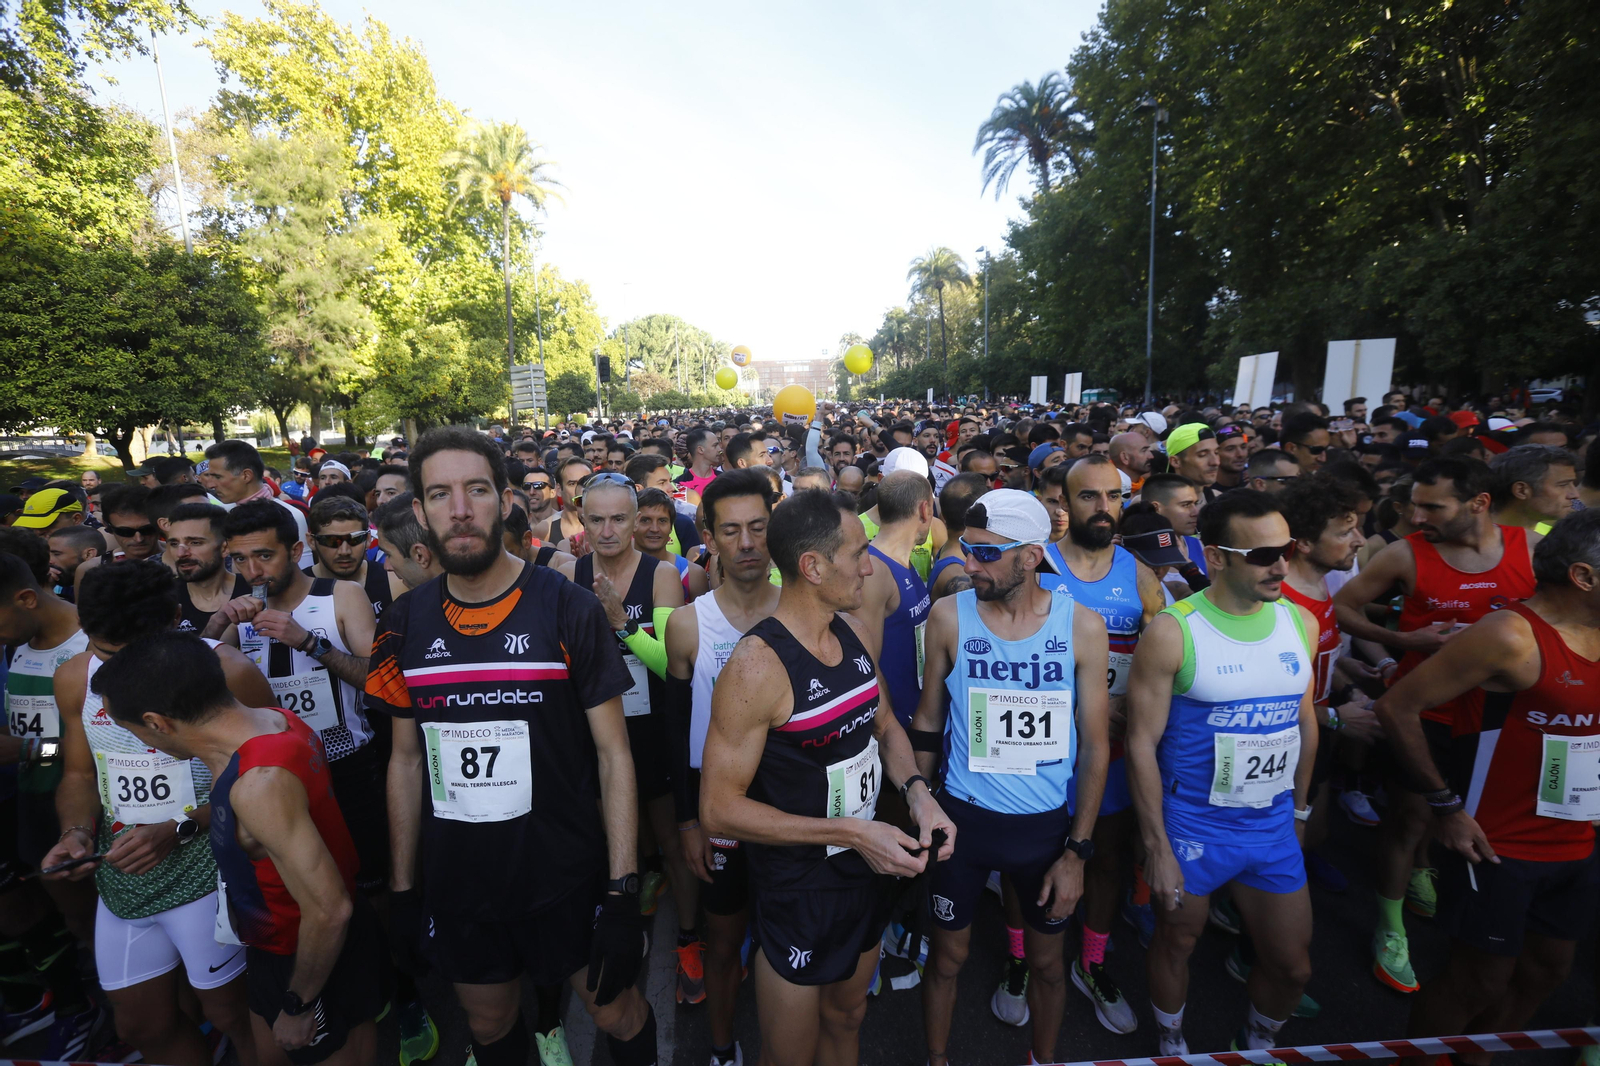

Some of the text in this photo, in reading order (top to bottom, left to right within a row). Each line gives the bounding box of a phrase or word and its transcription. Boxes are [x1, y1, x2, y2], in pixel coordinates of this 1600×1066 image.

[966, 640, 990, 651] TROPS
[967, 654, 1064, 690] nerja
[1216, 664, 1244, 675] GOBIK
[272, 680, 300, 689] IMDECO
[416, 688, 543, 709] runrundata
[1000, 695, 1038, 705] IMDECO
[1212, 704, 1254, 713] CLUB
[11, 712, 44, 736] 454
[1000, 710, 1051, 738] 131
[1526, 710, 1600, 727] SAN
[451, 728, 491, 739] IMDECO
[1248, 738, 1282, 748] IMDECO
[115, 759, 150, 768] IMDECO
[461, 746, 500, 779] 87
[1245, 751, 1288, 780] 244
[860, 764, 875, 802] 81
[1549, 764, 1559, 790] CAJÓN
[117, 774, 170, 802] 386
